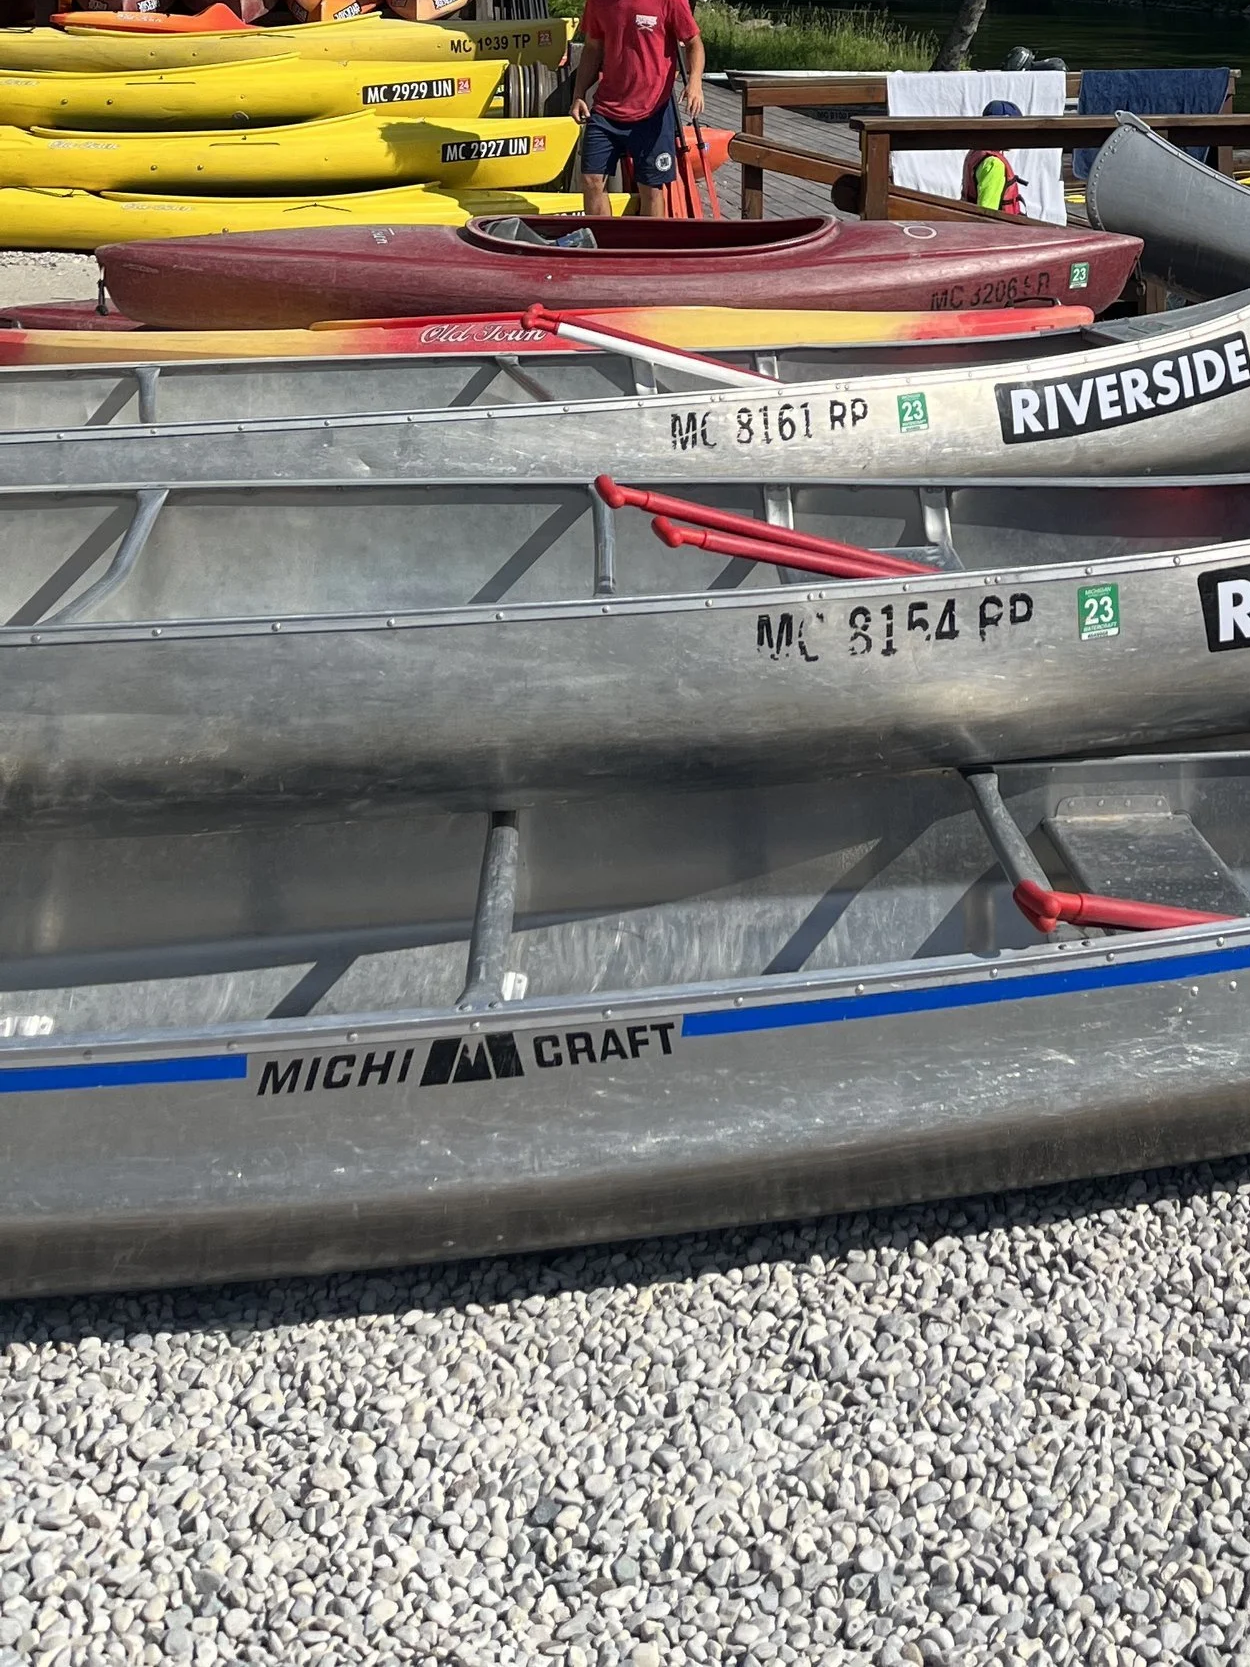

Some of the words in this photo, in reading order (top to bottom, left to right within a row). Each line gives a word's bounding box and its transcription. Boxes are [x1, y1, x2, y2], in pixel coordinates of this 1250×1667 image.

[450, 40, 472, 53] MC
[478, 36, 509, 51] 1939
[512, 34, 531, 48] TP
[367, 86, 388, 103] MC
[392, 82, 428, 101] 2929
[432, 80, 452, 97] UN
[458, 80, 469, 90] 24
[446, 144, 466, 161] MC
[470, 140, 505, 158] 2927
[508, 137, 528, 154] UN
[534, 138, 545, 147] 24
[1072, 267, 1086, 281] 23
[931, 285, 964, 310] MC
[421, 323, 473, 343] Old
[474, 323, 546, 342] Town
[1010, 339, 1250, 434] RIVERSIDE
[902, 399, 924, 422] 23
[671, 411, 717, 450] MC
[736, 402, 813, 444] 8161
[830, 397, 868, 431] RP
[1084, 595, 1114, 625] 23
[757, 612, 825, 662] MC
[848, 598, 960, 657] 8154
[256, 1048, 415, 1096] MICHI
[533, 1021, 676, 1069] CRAFT
